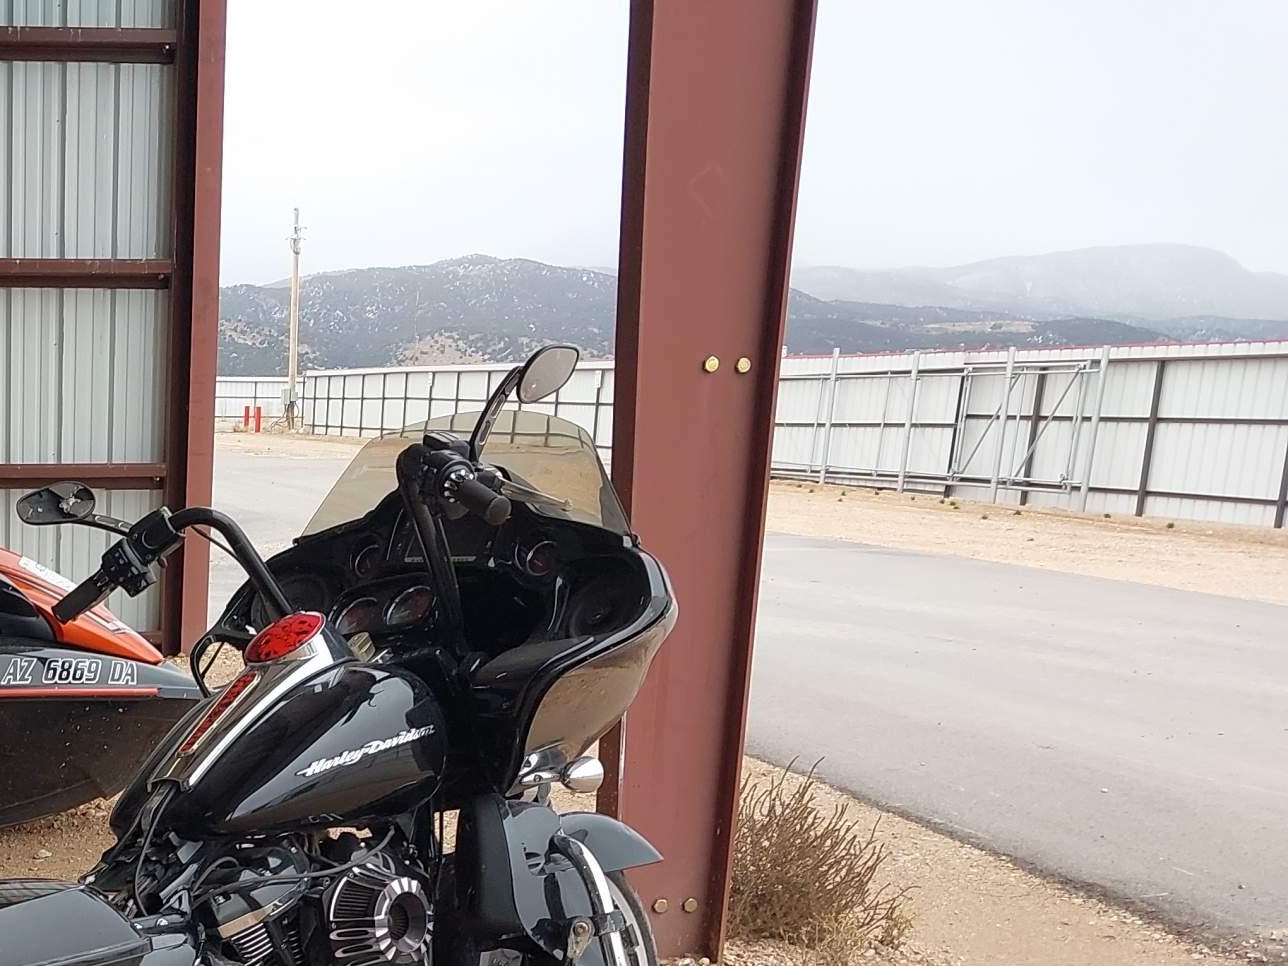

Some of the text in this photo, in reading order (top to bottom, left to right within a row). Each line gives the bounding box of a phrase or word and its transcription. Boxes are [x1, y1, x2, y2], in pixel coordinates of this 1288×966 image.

[1, 657, 137, 685] AZ 6869 DA
